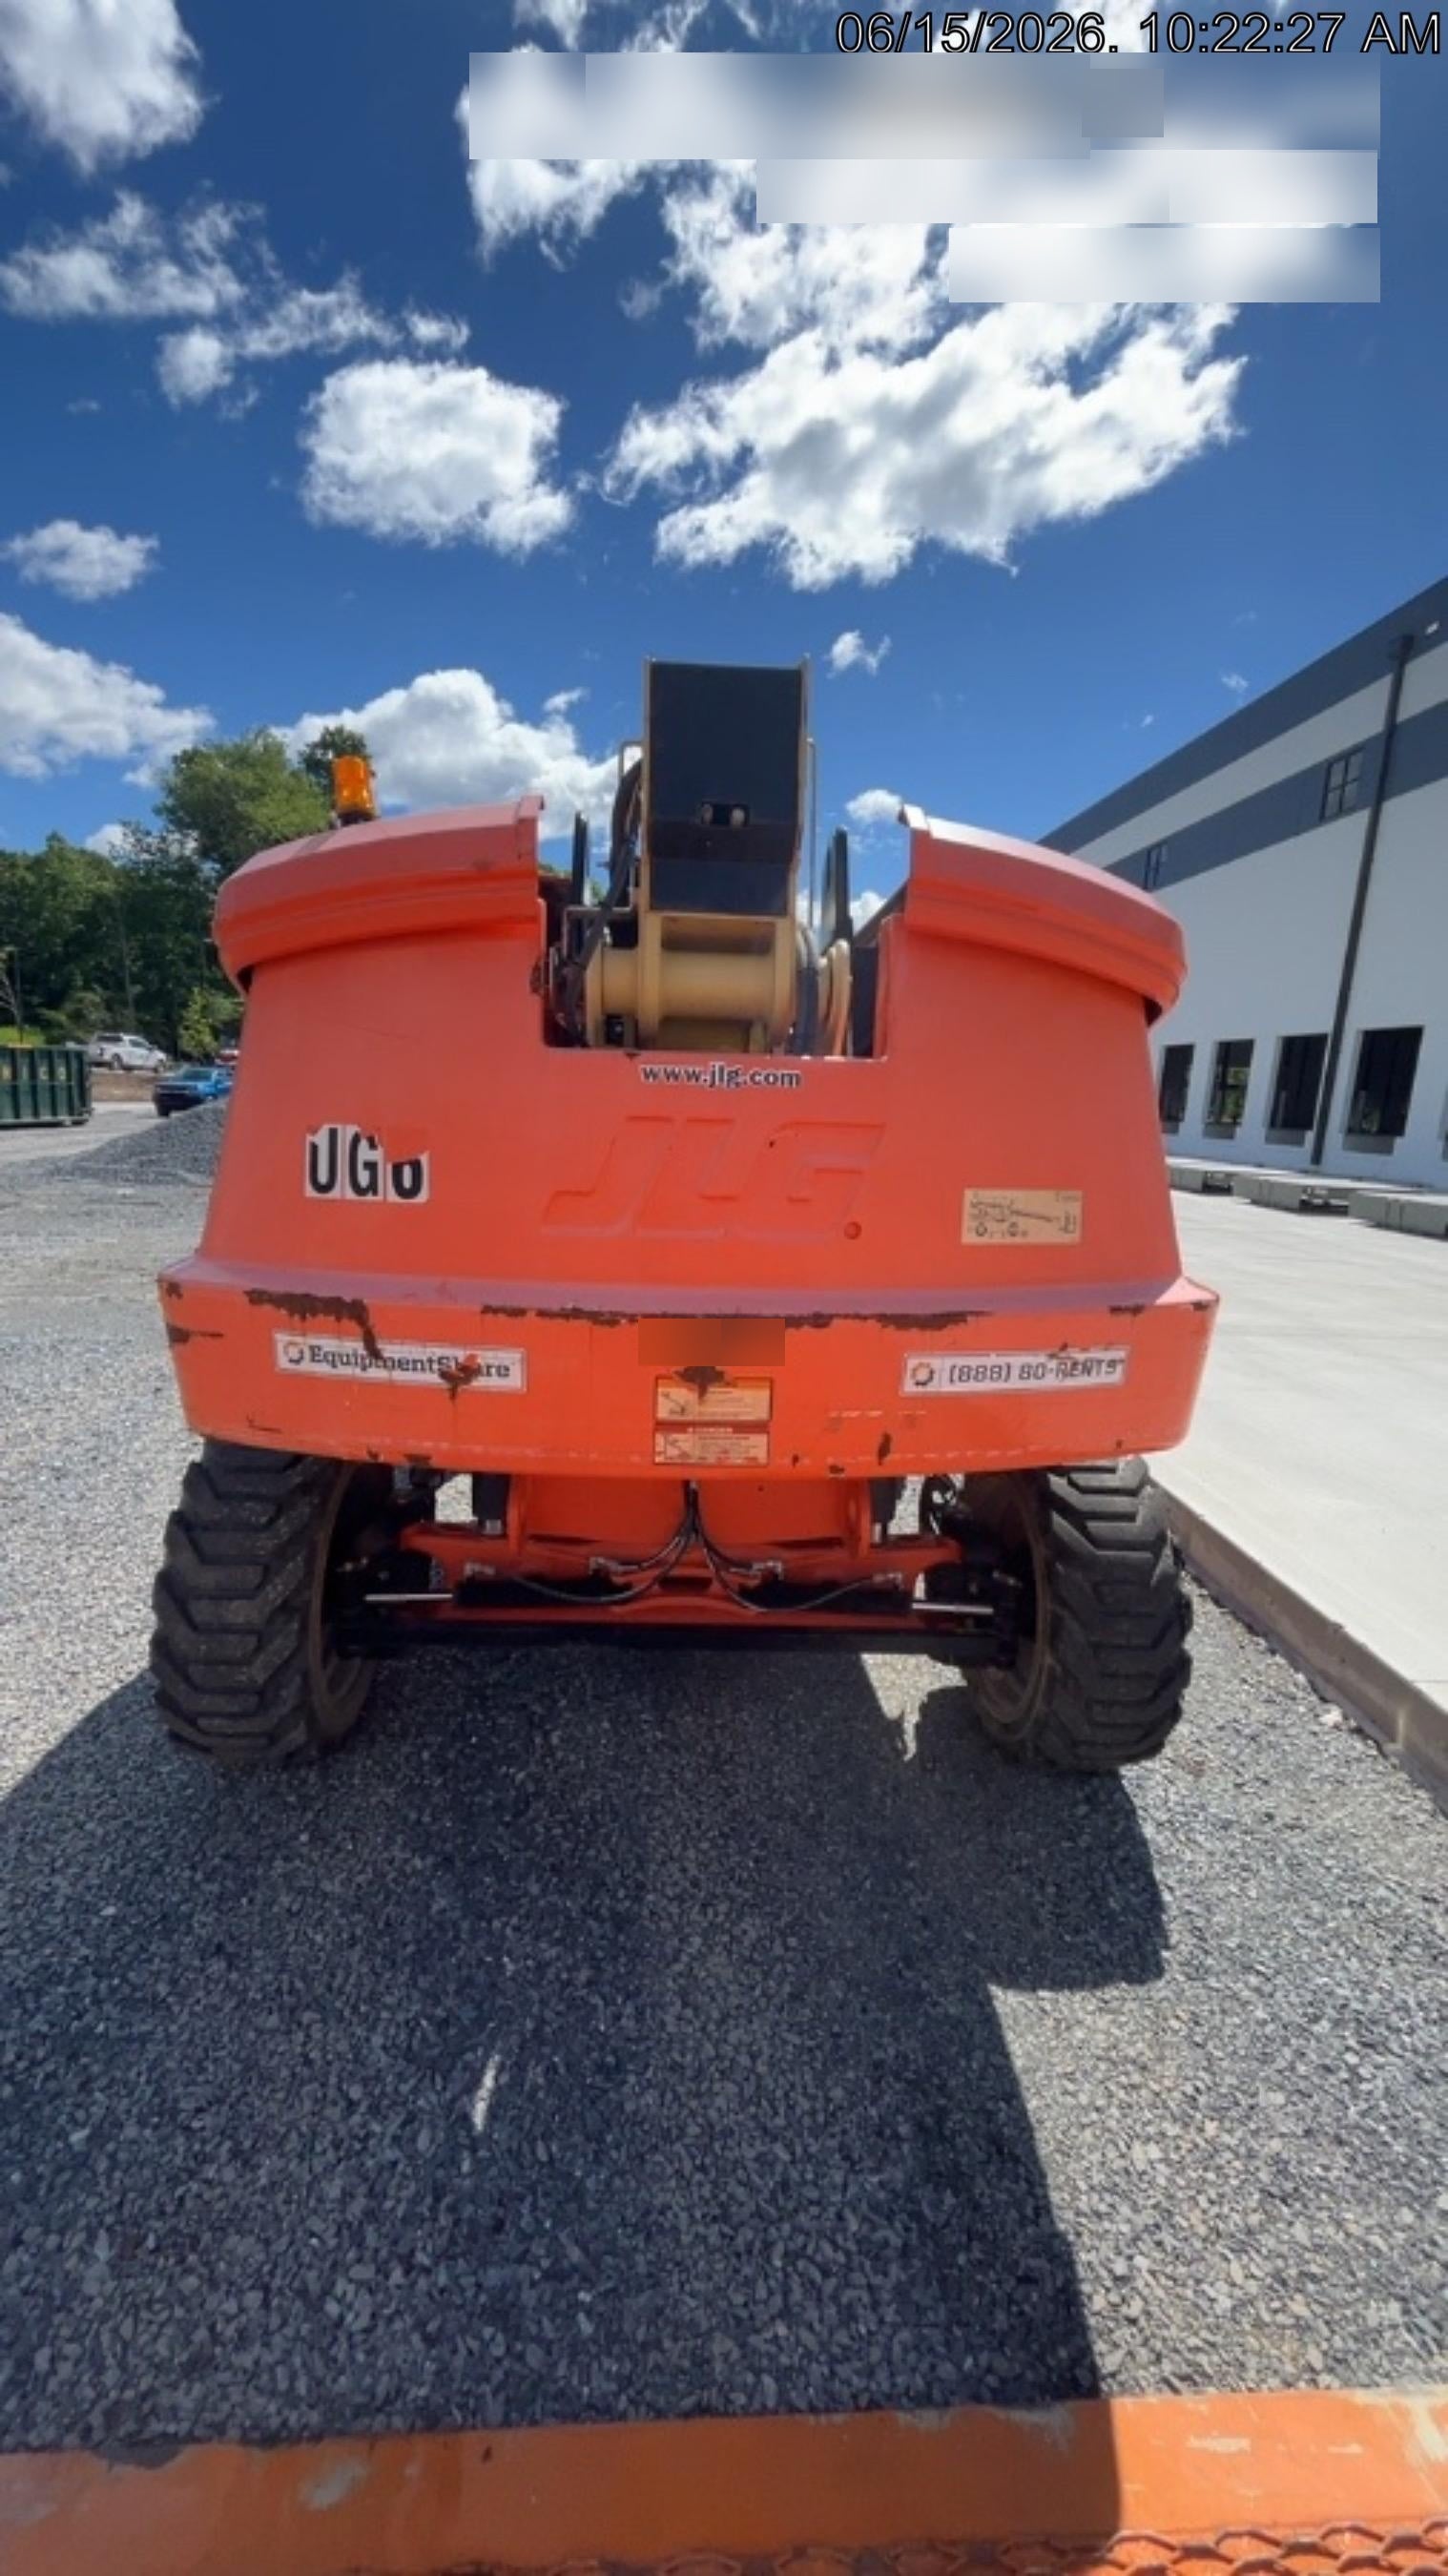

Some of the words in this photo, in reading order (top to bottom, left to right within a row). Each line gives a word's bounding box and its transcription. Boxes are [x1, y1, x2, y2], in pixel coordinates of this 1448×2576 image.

[641, 1063, 802, 1089] www.jlg.com
[540, 1114, 887, 1242] JLG
[948, 1363, 1011, 1384] (888)
